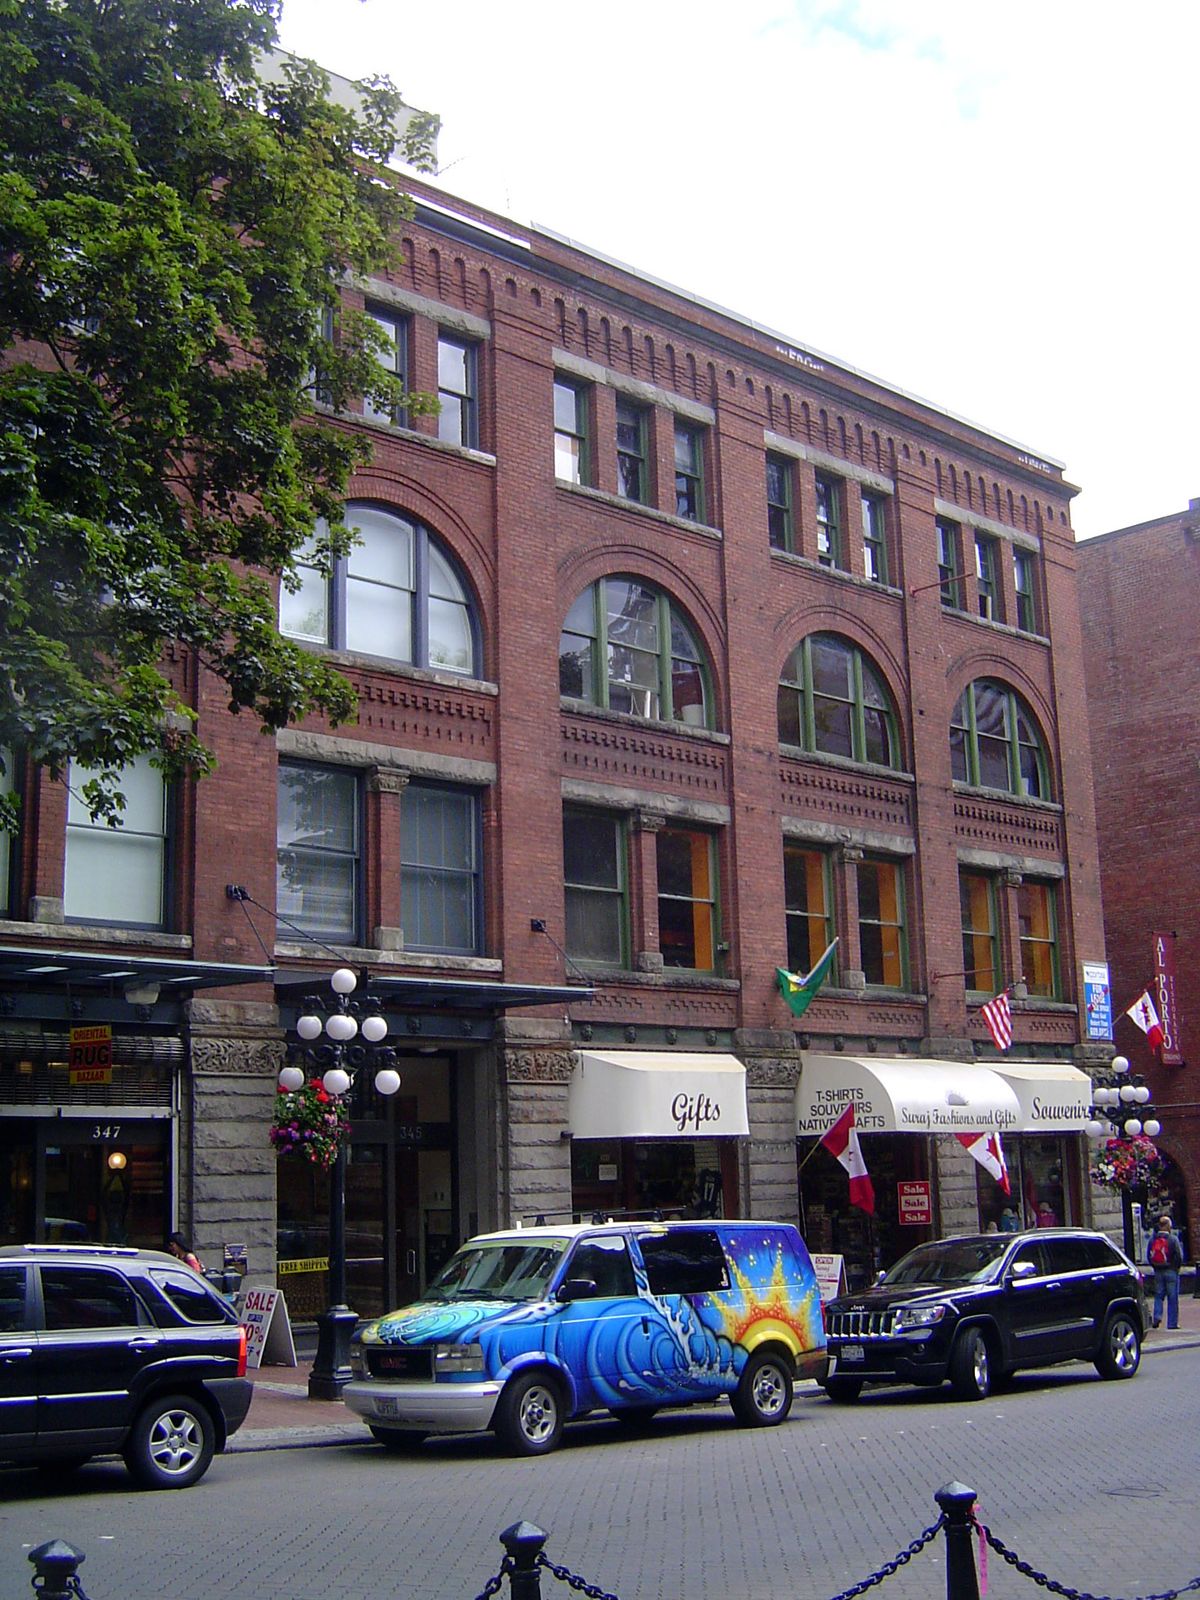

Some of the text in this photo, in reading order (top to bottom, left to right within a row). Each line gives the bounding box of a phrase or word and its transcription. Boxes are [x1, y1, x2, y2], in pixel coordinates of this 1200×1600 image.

[74, 1028, 108, 1040] ORIENTAL
[73, 1045, 109, 1066] RUG
[76, 1070, 105, 1082] BAZAAR
[816, 1088, 864, 1102] T-SHIRTS
[671, 1093, 721, 1131] Gifts
[810, 1101, 873, 1116] SOUVEIRS
[855, 1115, 886, 1128] AFTS
[901, 1107, 1017, 1130] Suraj Fashions and Gifts
[92, 1125, 121, 1139] 347
[903, 1185, 925, 1194] Sale
[904, 1199, 926, 1207] Sale
[904, 1213, 927, 1222] Sale
[280, 1257, 329, 1273] FREE SHIPPIN
[245, 1291, 276, 1312] SALE
